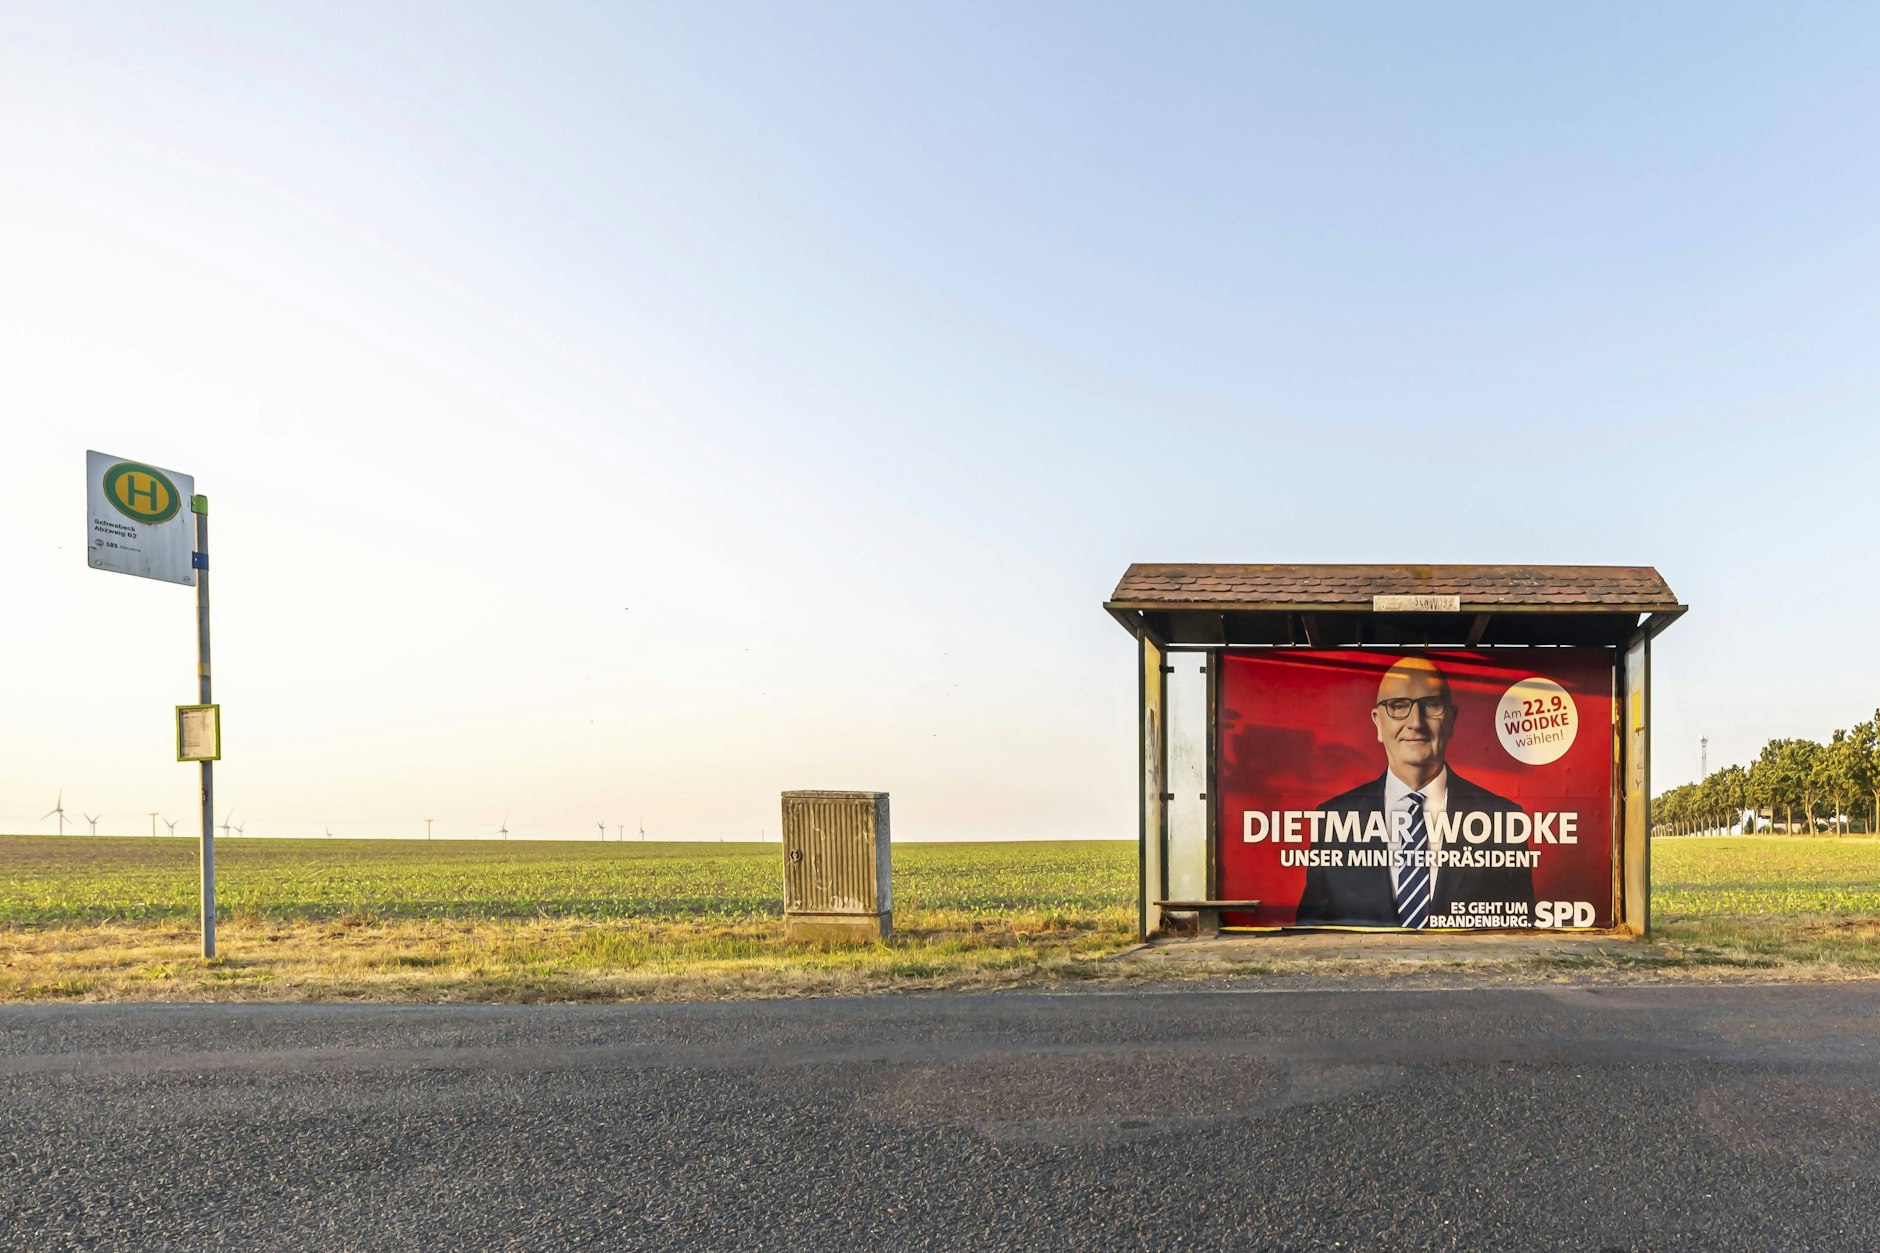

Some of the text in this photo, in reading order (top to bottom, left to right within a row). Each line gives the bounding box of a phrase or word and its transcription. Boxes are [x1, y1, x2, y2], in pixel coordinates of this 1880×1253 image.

[127, 475, 157, 511] H
[94, 519, 136, 532] Schwabeck
[94, 526, 126, 538] Abzweig
[1503, 695, 1567, 720] Am 22.9.
[1504, 713, 1569, 735] WOIDKE
[1515, 729, 1564, 748] wählen!
[1243, 810, 1578, 844] DIETMAR WOIDKE
[1280, 846, 1541, 868] UNSER MINISTERPRÄSIDENT
[1451, 902, 1528, 914] ES GEHT UM
[1534, 901, 1596, 928] SPD
[1429, 915, 1531, 928] BRANDENBURG.
